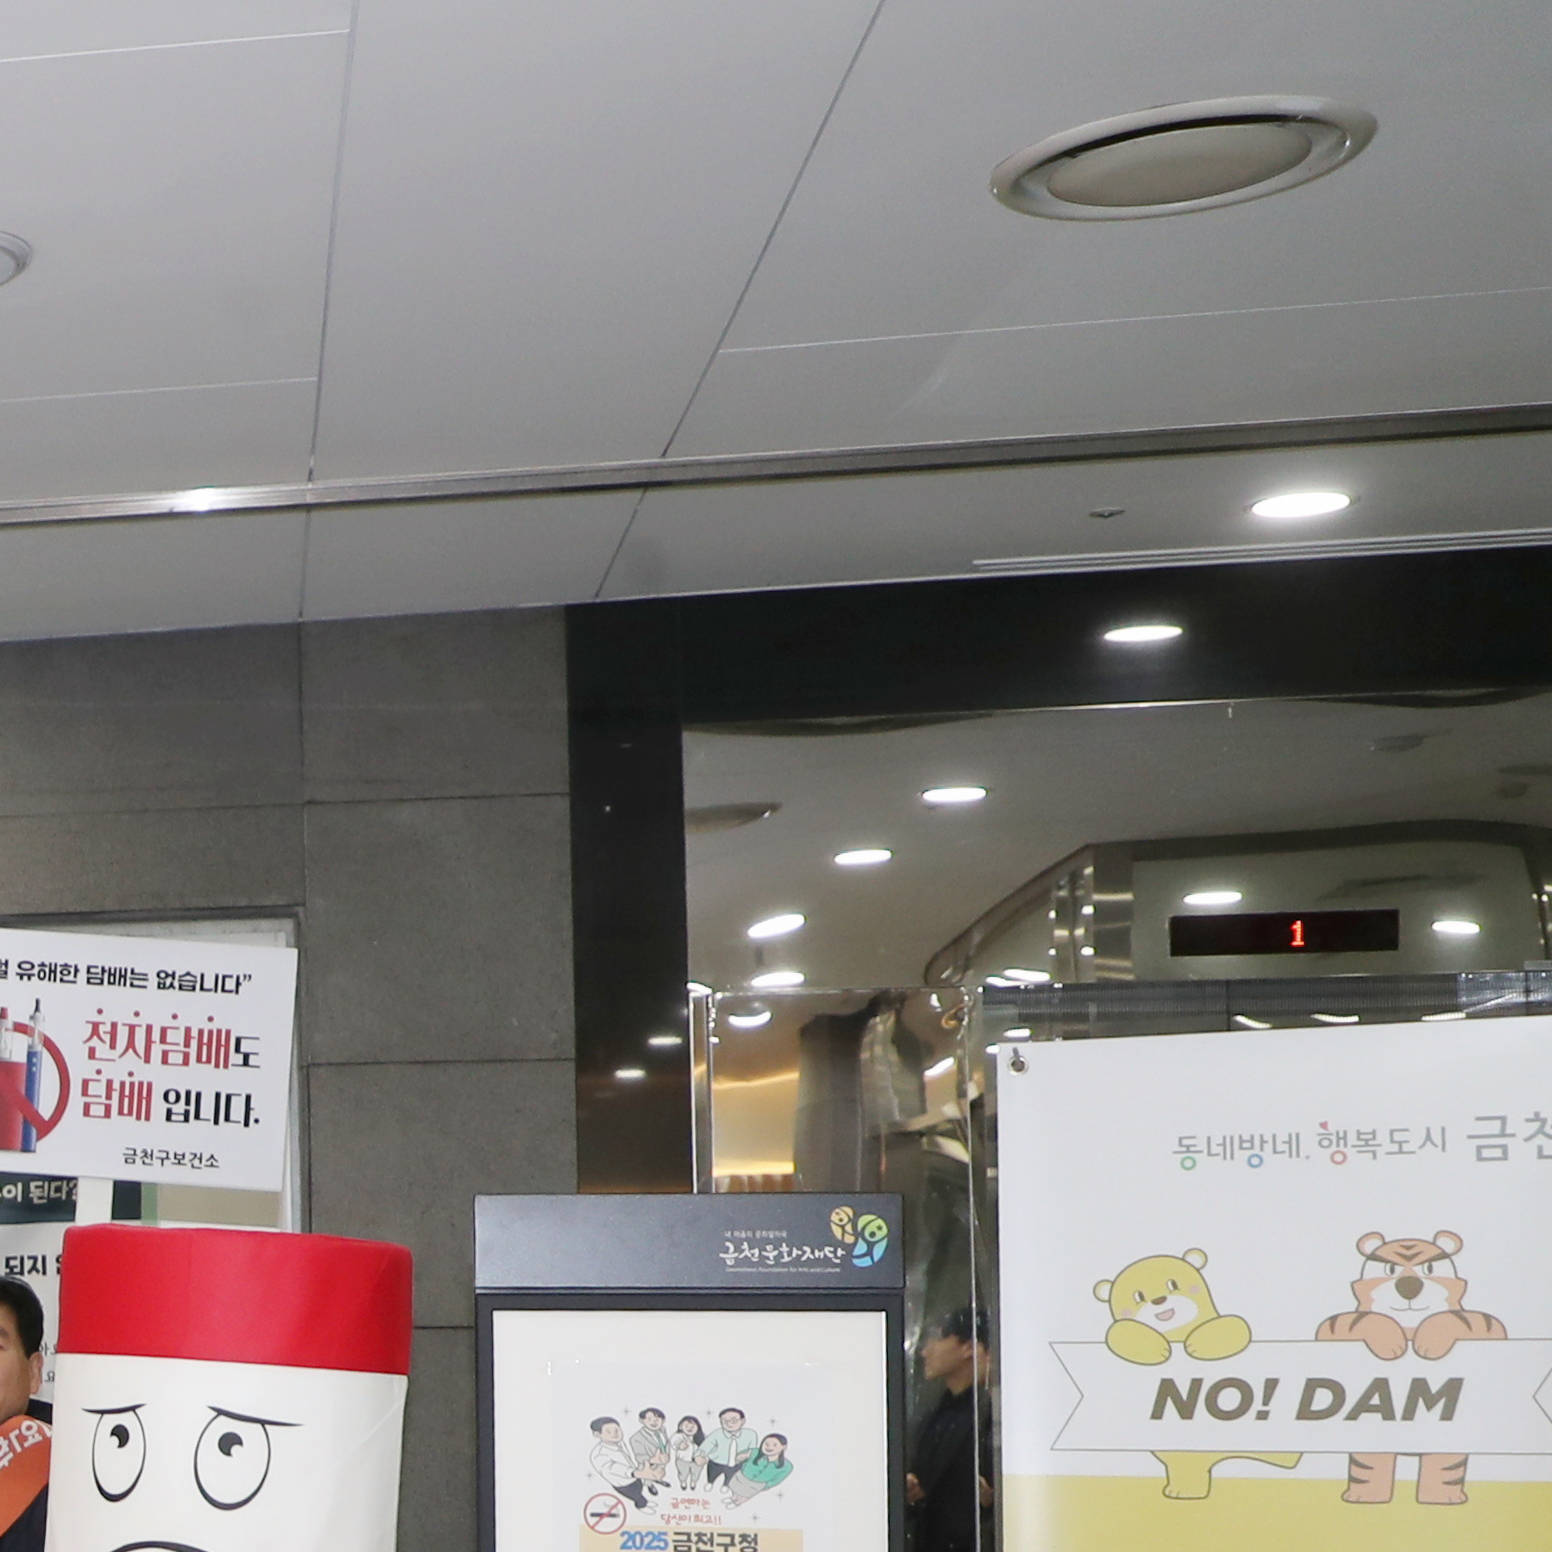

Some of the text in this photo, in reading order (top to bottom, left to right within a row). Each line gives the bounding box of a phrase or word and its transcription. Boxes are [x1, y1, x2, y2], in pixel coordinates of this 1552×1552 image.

[1290, 920, 1306, 947] 1
[16, 961, 80, 985] 유해한
[85, 964, 149, 990] 담배는
[82, 1014, 261, 1070] 전자담배도
[81, 1074, 260, 1128] 담배 입니다.
[123, 1147, 220, 1170] 금천구보건소
[1172, 1131, 1310, 1170] 동네방네.
[1318, 1120, 1447, 1165] 행복도시
[29, 1180, 78, 1204] 된다?
[4, 1255, 47, 1276] 되지
[719, 1241, 846, 1265] 금천문화재단
[1150, 1377, 1464, 1422] NO! DAM
[619, 1531, 669, 1551] 2025
